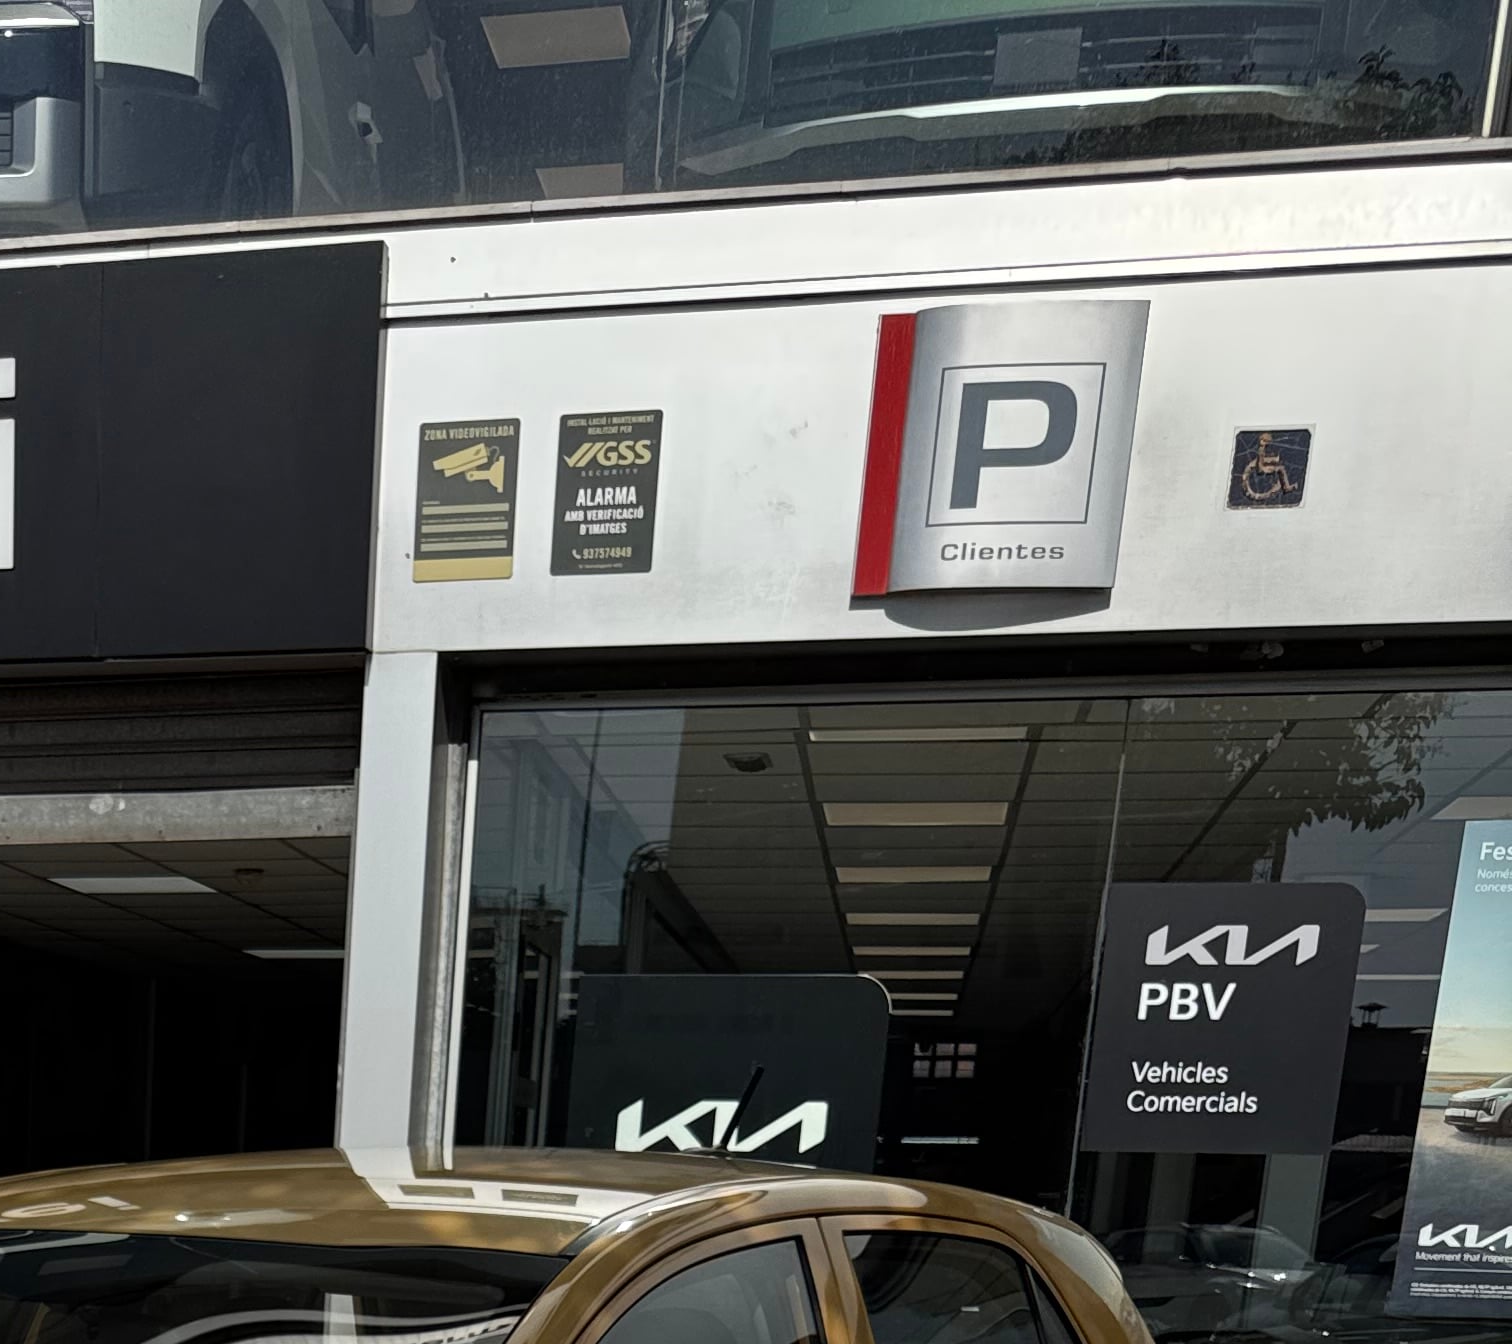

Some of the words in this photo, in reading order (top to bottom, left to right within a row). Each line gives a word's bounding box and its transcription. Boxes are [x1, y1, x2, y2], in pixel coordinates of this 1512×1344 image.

[424, 429, 448, 441] ZONA
[449, 425, 515, 439] VIDEOVIGILADA
[949, 380, 1078, 510] P
[581, 468, 639, 477] SECURITY
[575, 486, 637, 507] ALARMA
[564, 510, 585, 522] AMB
[586, 505, 644, 521] VERIFICACIÓ
[579, 522, 627, 535] D'IMATGES
[582, 546, 633, 559] 937574949
[940, 542, 1065, 561] Clientes
[1145, 924, 1321, 967] KIA
[1137, 982, 1237, 1020] PBV
[1131, 1061, 1229, 1083] Vehicles
[1126, 1090, 1258, 1113] Comercials
[615, 1099, 829, 1154] KIA
[1418, 1223, 1512, 1250] KIA
[1415, 1251, 1461, 1262] Movement
[1463, 1253, 1480, 1262] that
